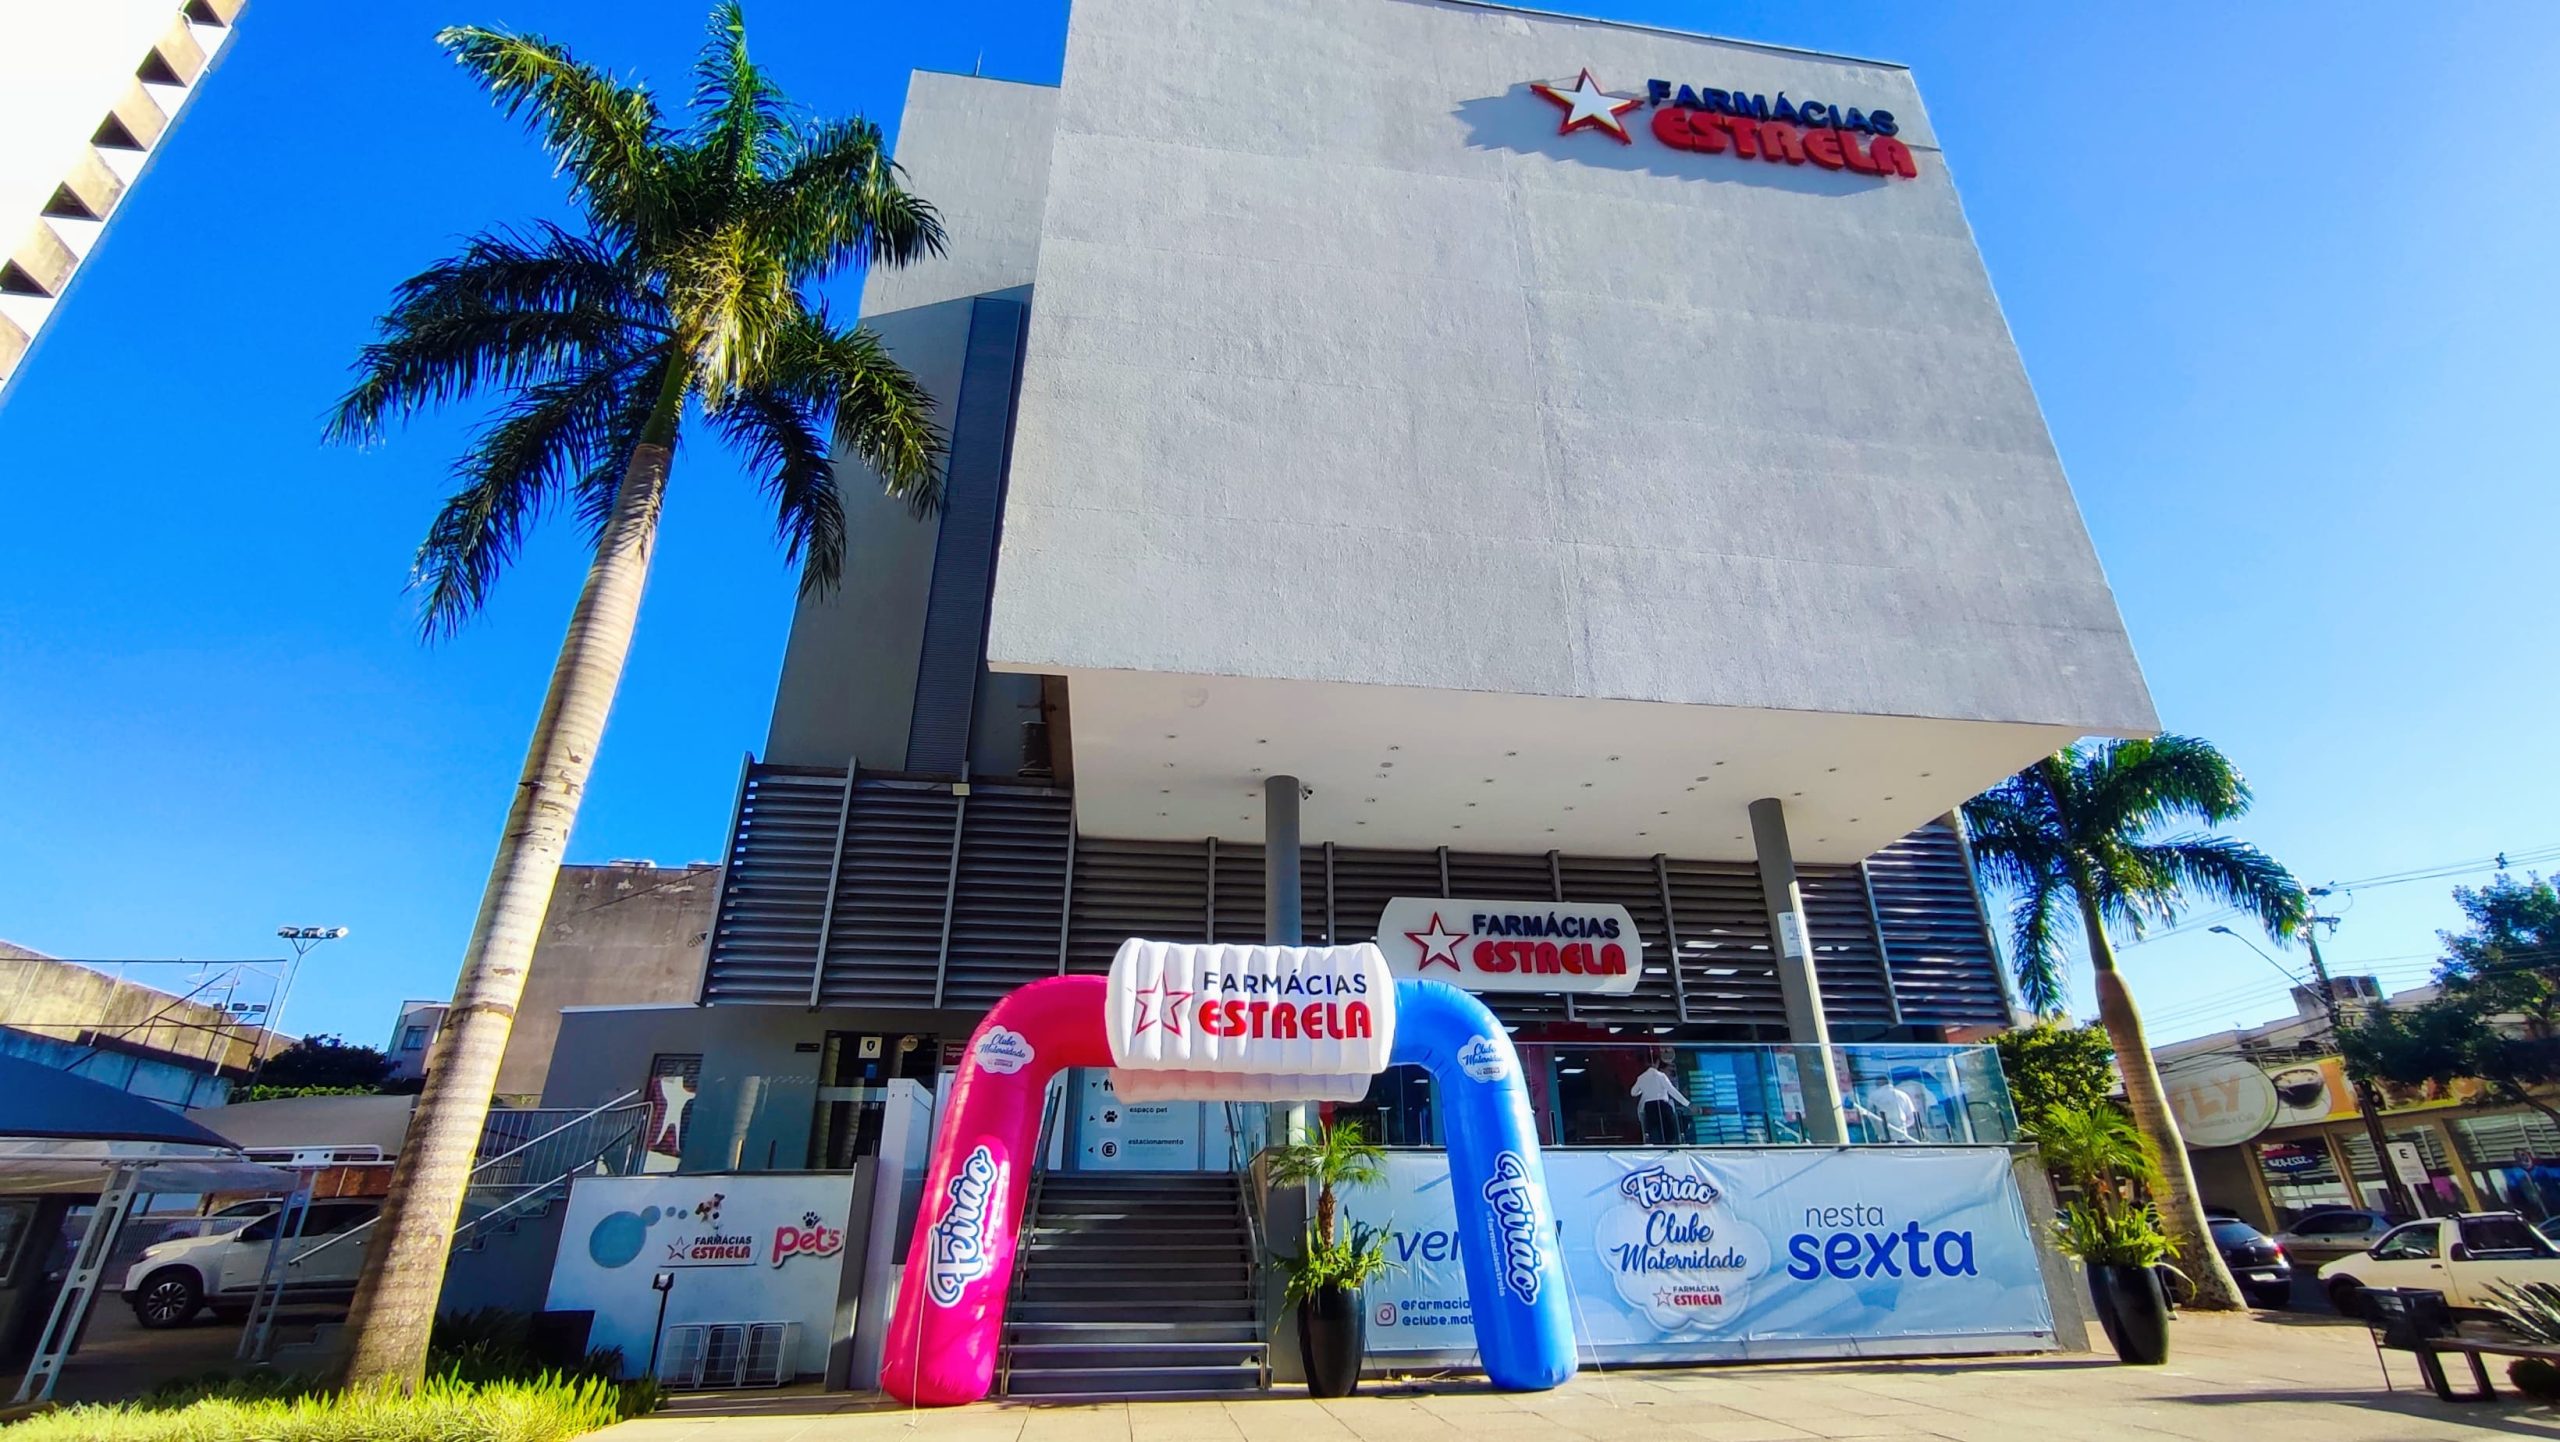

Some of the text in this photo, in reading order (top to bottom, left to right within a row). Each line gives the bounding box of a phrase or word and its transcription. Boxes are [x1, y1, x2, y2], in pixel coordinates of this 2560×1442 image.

[1647, 78, 1899, 136] FARMÁCIAS
[1651, 107, 1917, 178] ESTRELA
[1472, 911, 1620, 939] FARMÁCIAS
[1472, 941, 1627, 975] ESTRELA
[1203, 969, 1367, 995] FARMÁCIAS
[1199, 1000, 1372, 1040] ESTRELA
[1621, 1165, 1719, 1209] Feirão
[929, 1148, 994, 1305] Feirão
[1484, 1152, 1541, 1304] Feirão
[1646, 1210, 1714, 1247] Clube
[1805, 1203, 1885, 1229] nesta
[691, 1246, 750, 1259] ESTRELA
[1610, 1243, 1747, 1274] Maternidade
[1787, 1221, 1979, 1281] sexta
[1673, 1285, 1720, 1293] FARMÁCIAS
[1674, 1294, 1722, 1306] ESTRELA
